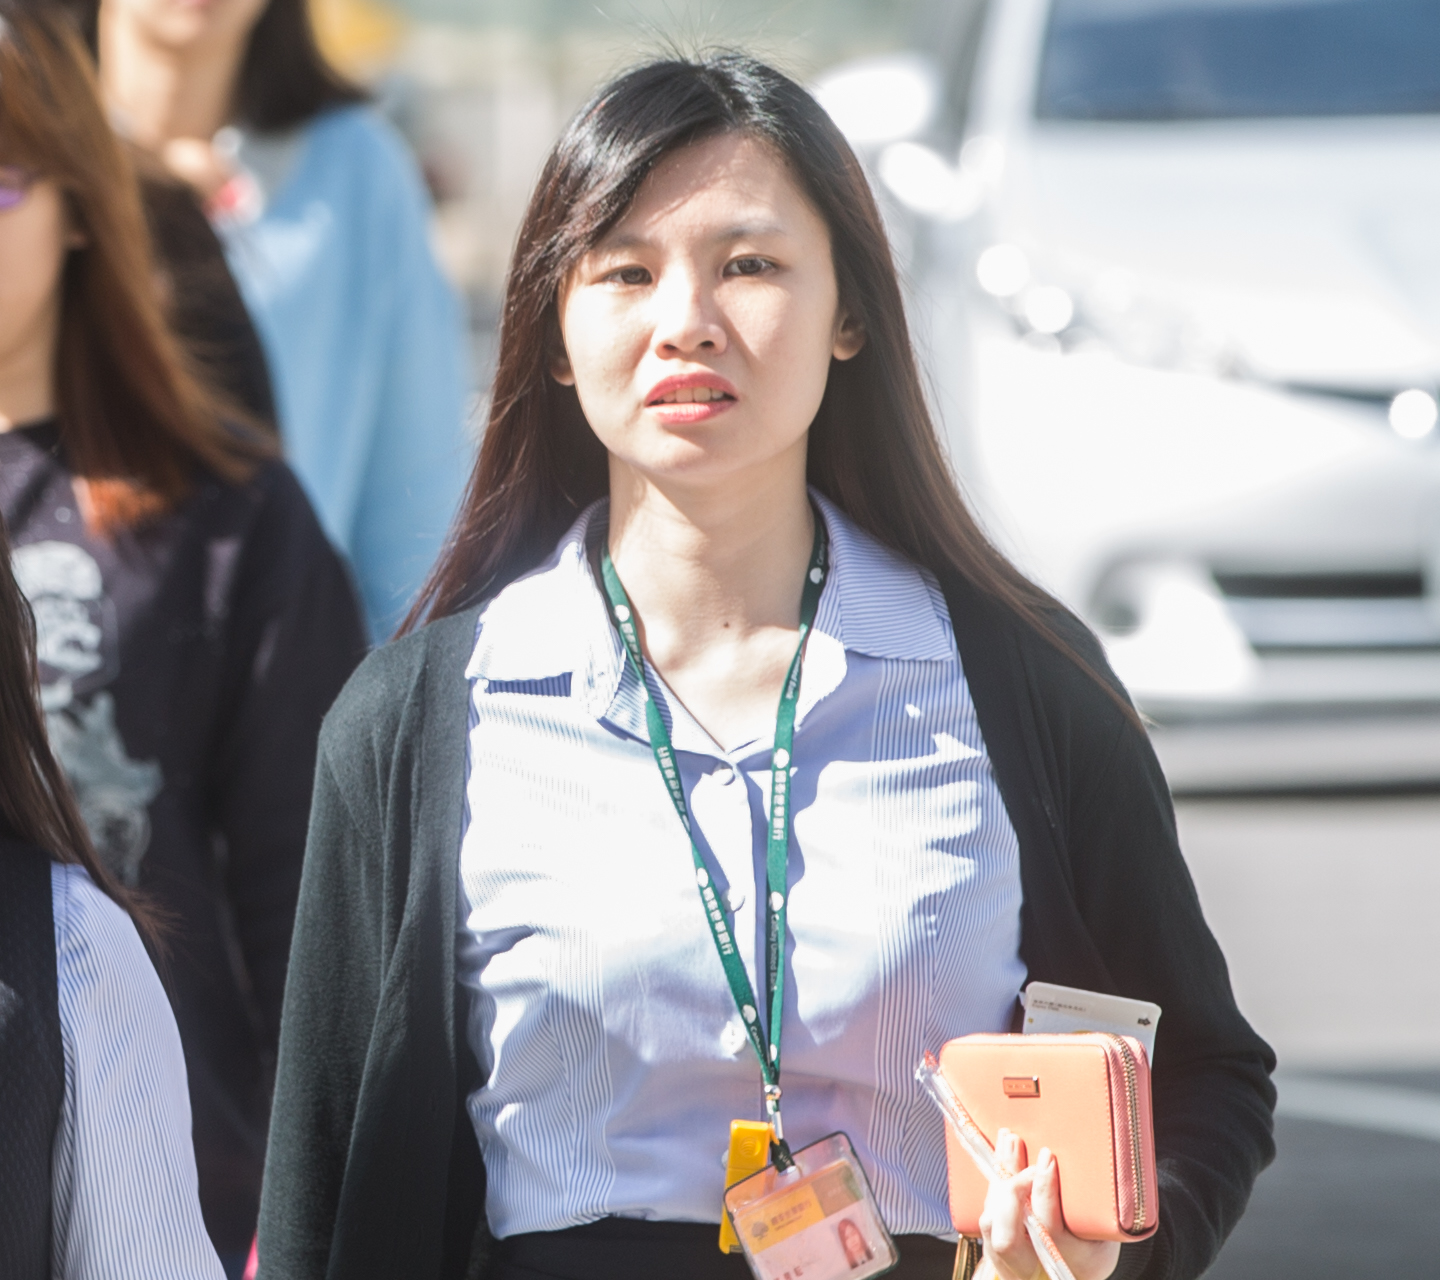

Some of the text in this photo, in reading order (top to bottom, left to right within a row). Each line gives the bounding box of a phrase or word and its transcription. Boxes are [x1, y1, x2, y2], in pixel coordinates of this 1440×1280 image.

[772, 769, 787, 840] 國泰世華銀行
[703, 887, 734, 955] 國泰世華銀行
